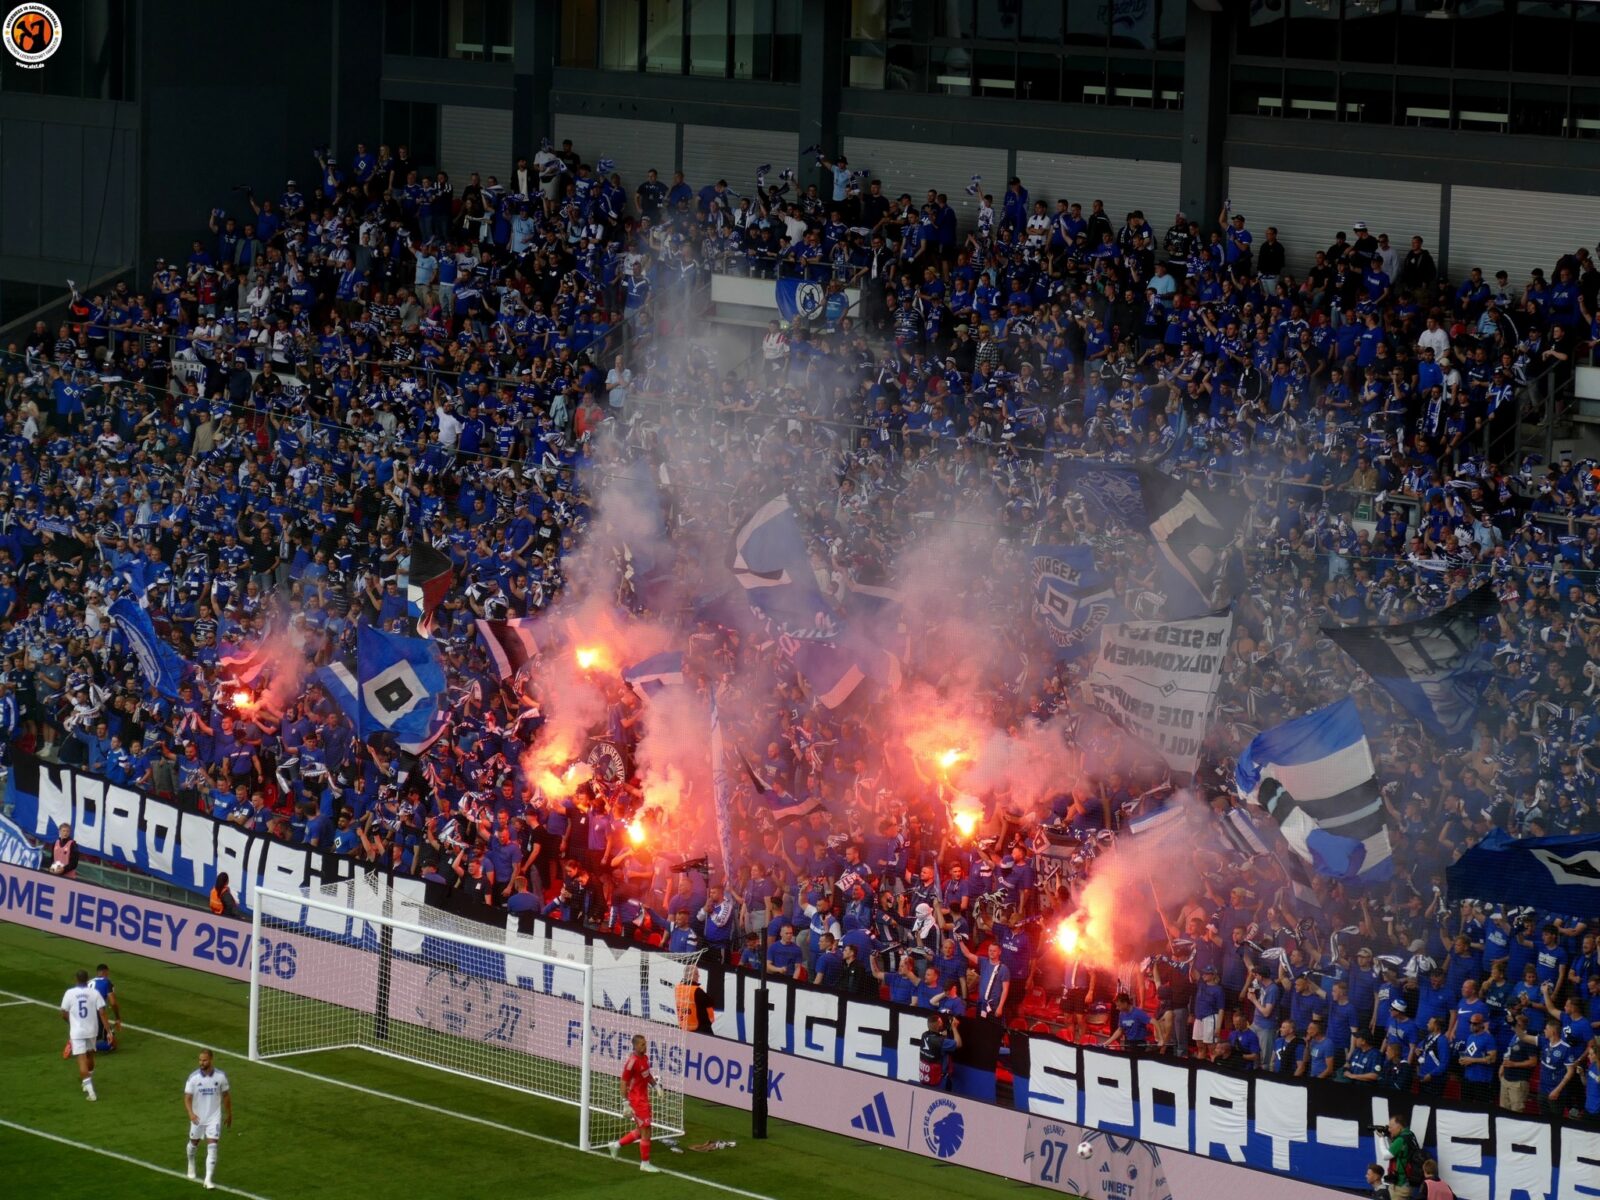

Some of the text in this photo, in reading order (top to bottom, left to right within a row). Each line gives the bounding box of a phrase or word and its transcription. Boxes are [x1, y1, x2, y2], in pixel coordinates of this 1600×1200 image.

[60, 891, 188, 951] JERSEY
[193, 923, 297, 980] 25/26
[78, 1000, 88, 1019] 5
[1040, 1139, 1069, 1184] 27
